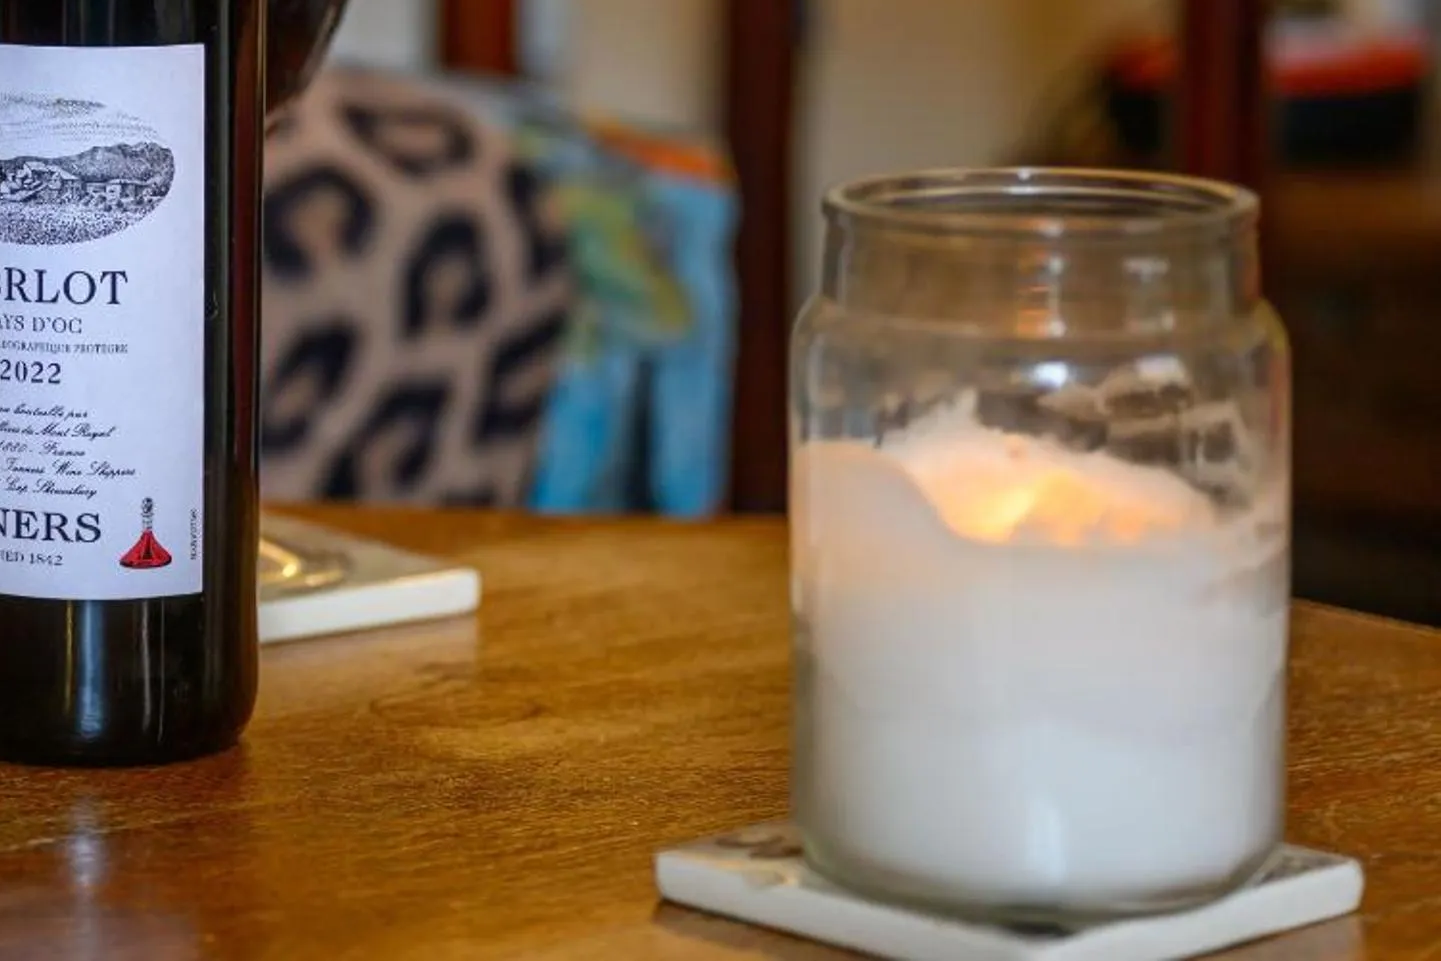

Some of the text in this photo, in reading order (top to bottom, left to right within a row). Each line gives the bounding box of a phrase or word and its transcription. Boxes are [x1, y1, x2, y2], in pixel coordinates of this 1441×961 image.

[32, 317, 83, 334] D'OC
[0, 359, 62, 384] 2022
[71, 422, 117, 440] Royal
